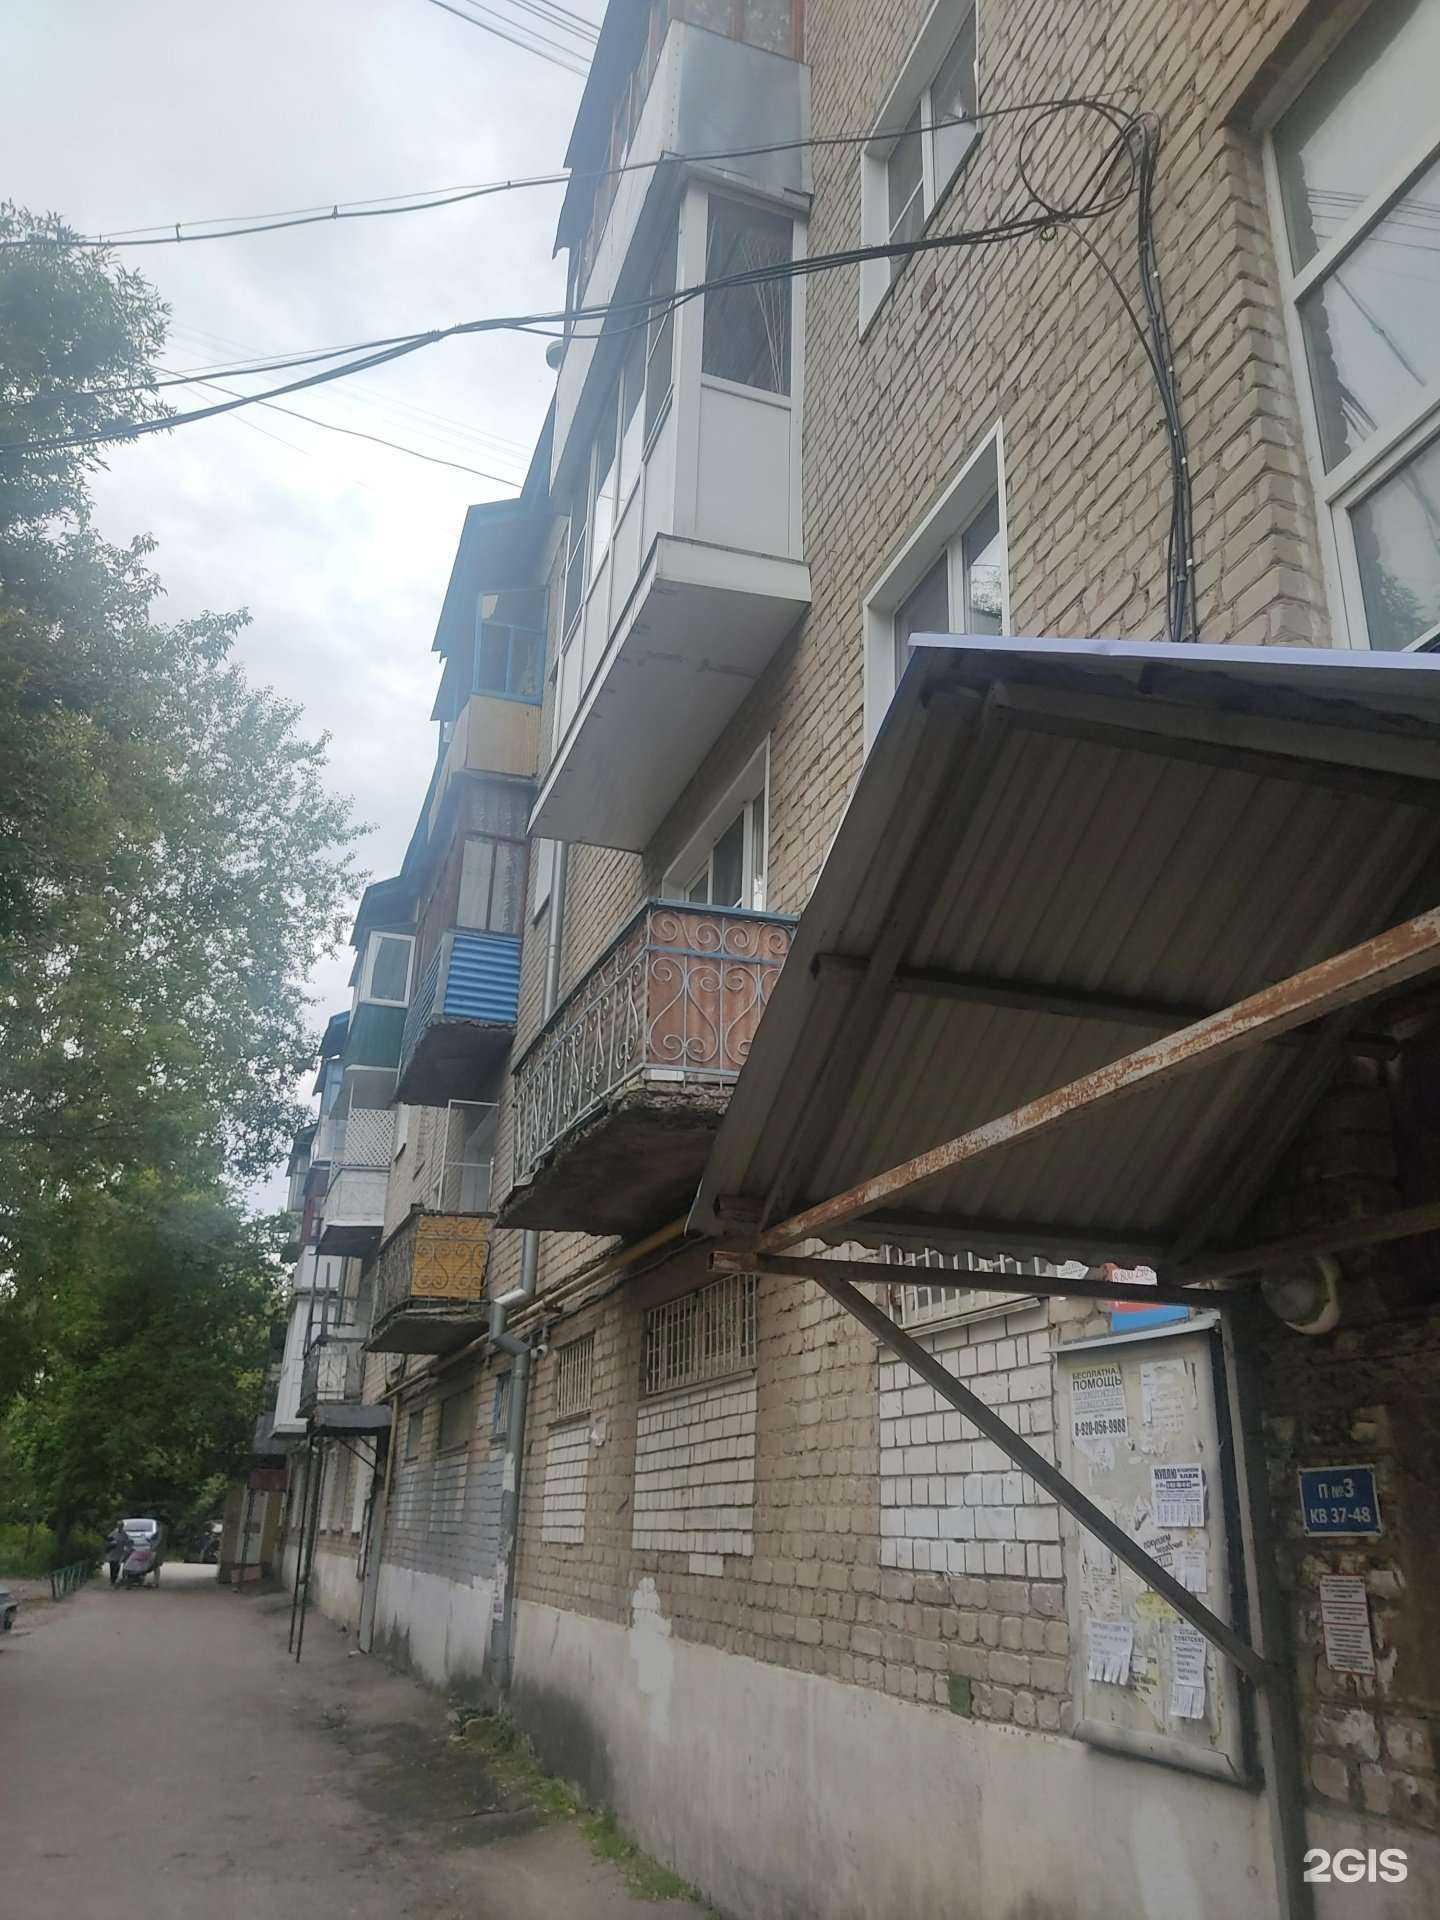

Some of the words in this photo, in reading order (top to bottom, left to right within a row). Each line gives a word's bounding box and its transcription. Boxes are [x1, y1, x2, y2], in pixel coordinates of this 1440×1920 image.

[1072, 1366, 1121, 1380] БЕСПЛАТНА
[1072, 1375, 1122, 1392] ПОМОЩЬ
[1317, 1483, 1329, 1499] П
[1310, 1507, 1328, 1524] КВ
[1330, 1506, 1371, 1523] 37-48
